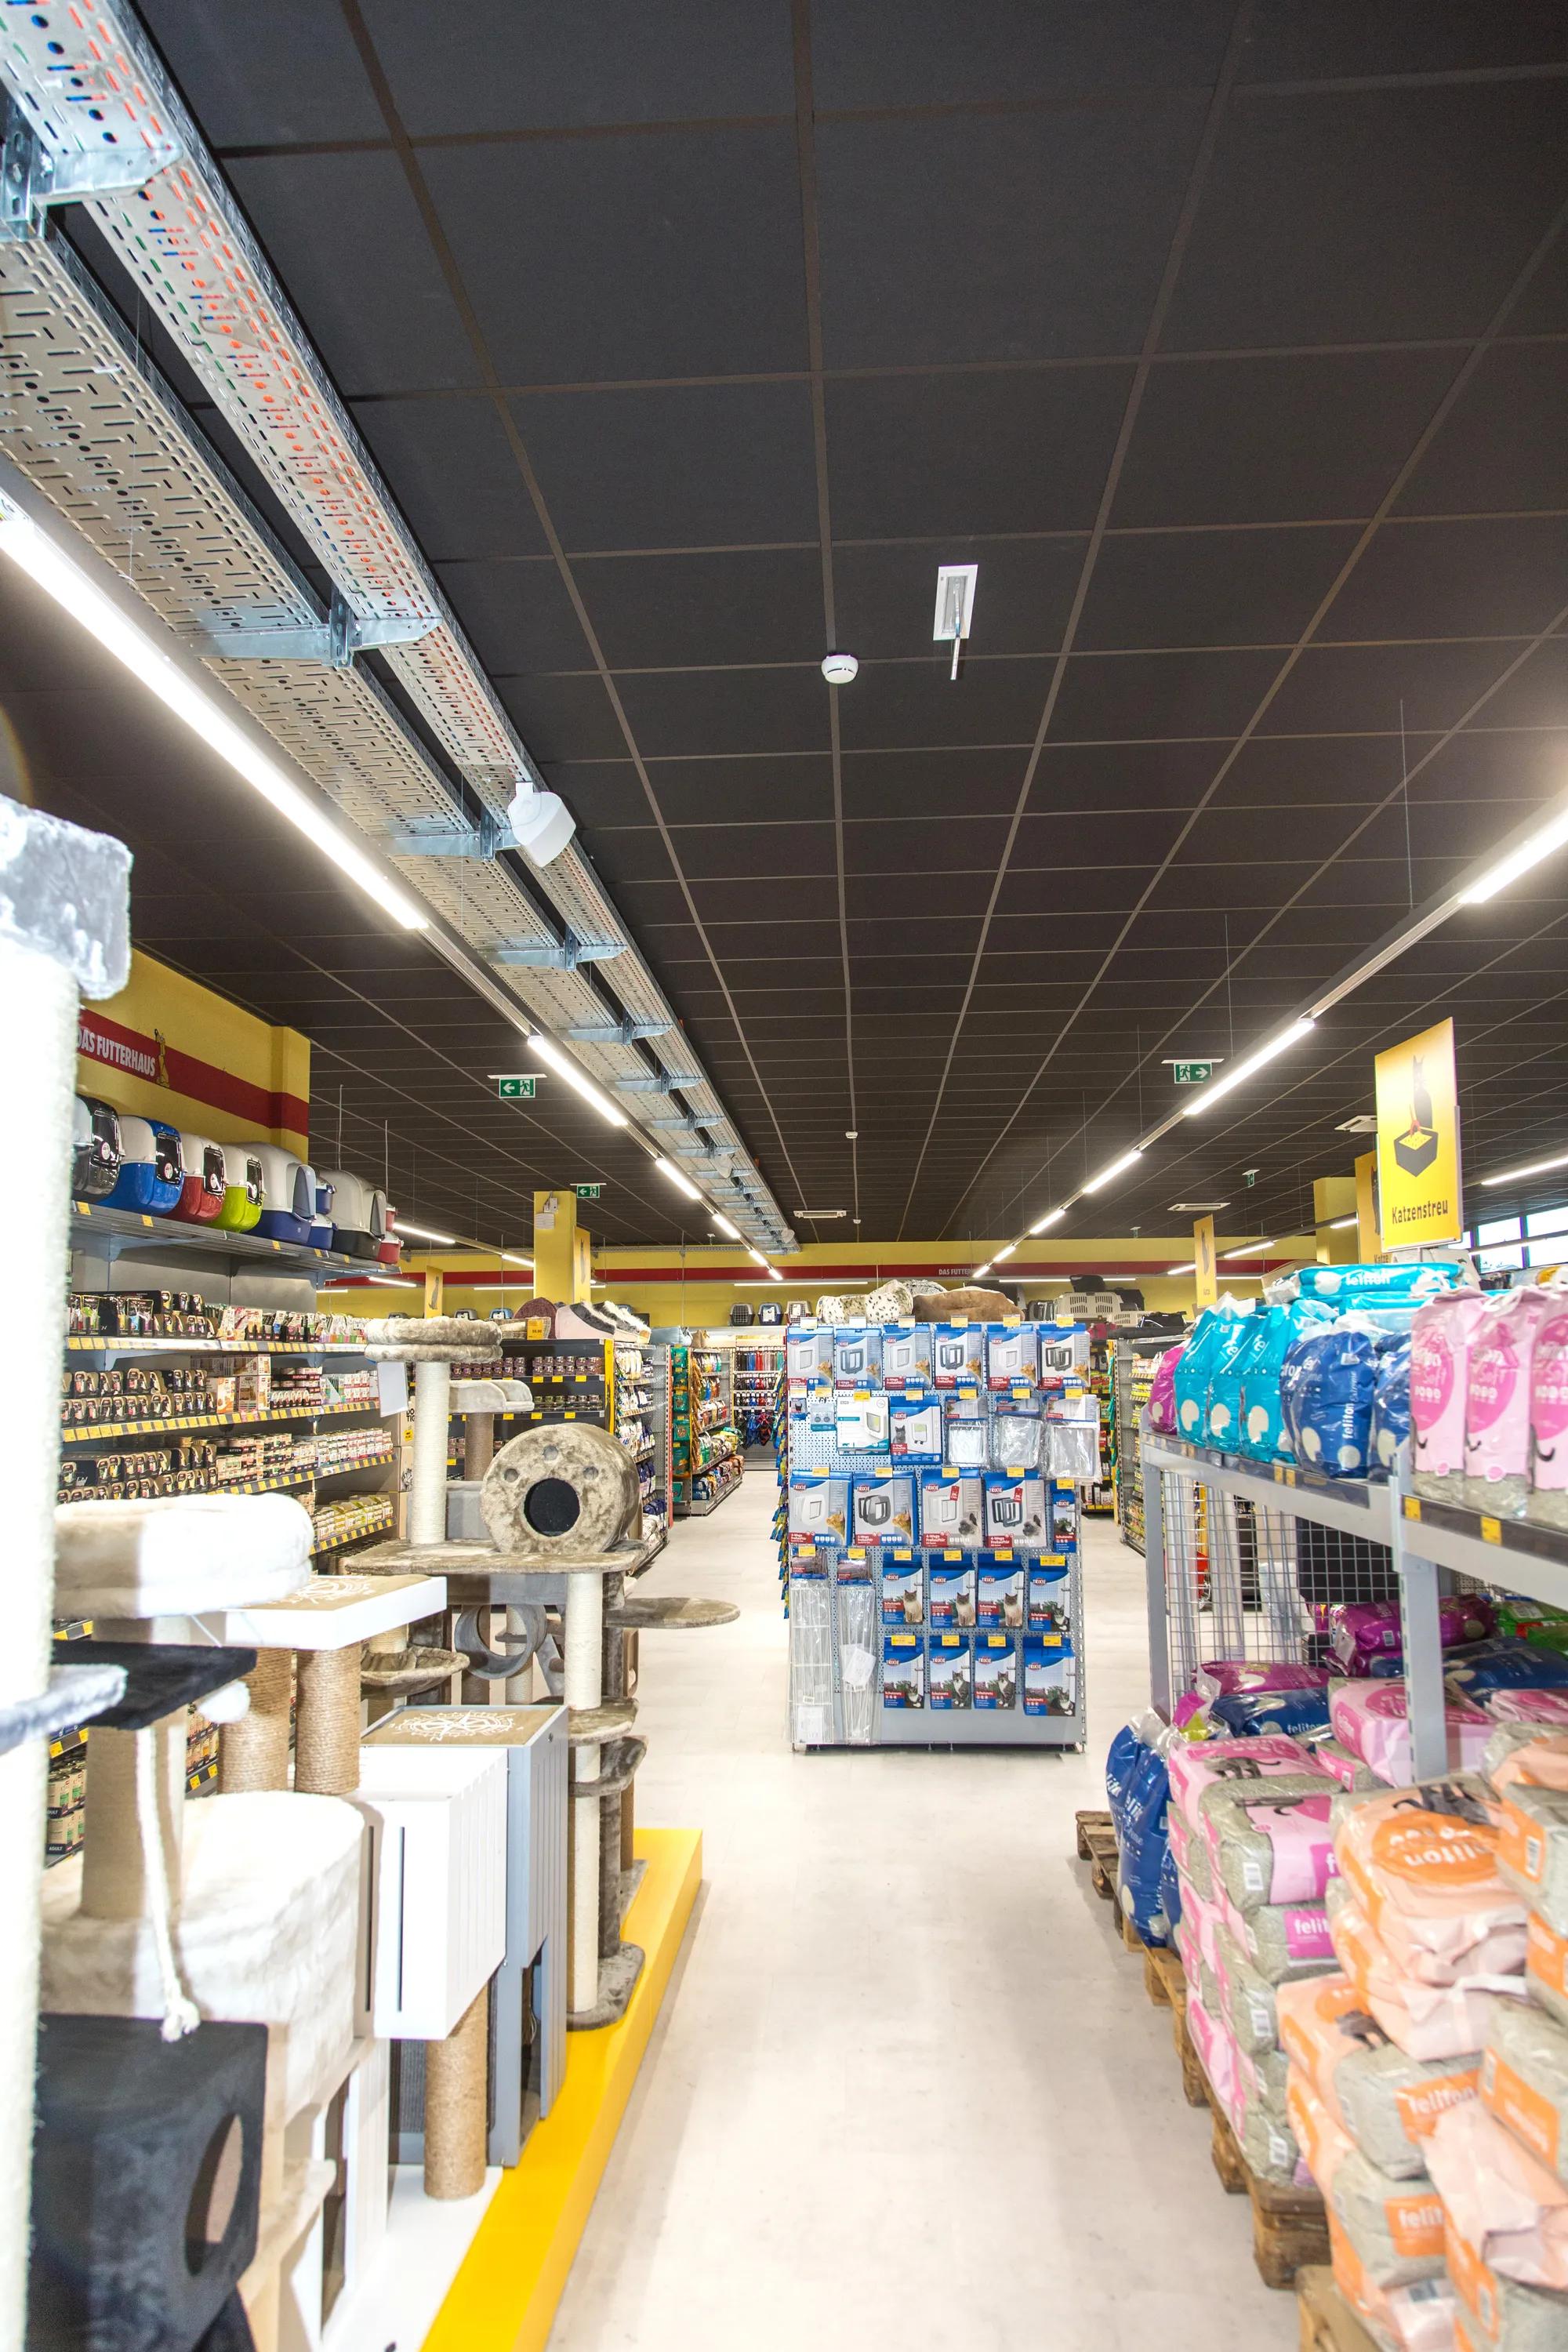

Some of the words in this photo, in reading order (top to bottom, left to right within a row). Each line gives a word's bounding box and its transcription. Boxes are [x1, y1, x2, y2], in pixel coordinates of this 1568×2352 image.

[96, 1035, 156, 1076] FUTTERHAUS
[1392, 1200, 1448, 1225] Katzenstreu
[1342, 1403, 1355, 1439] feliton
[1294, 1918, 1330, 1936] felit
